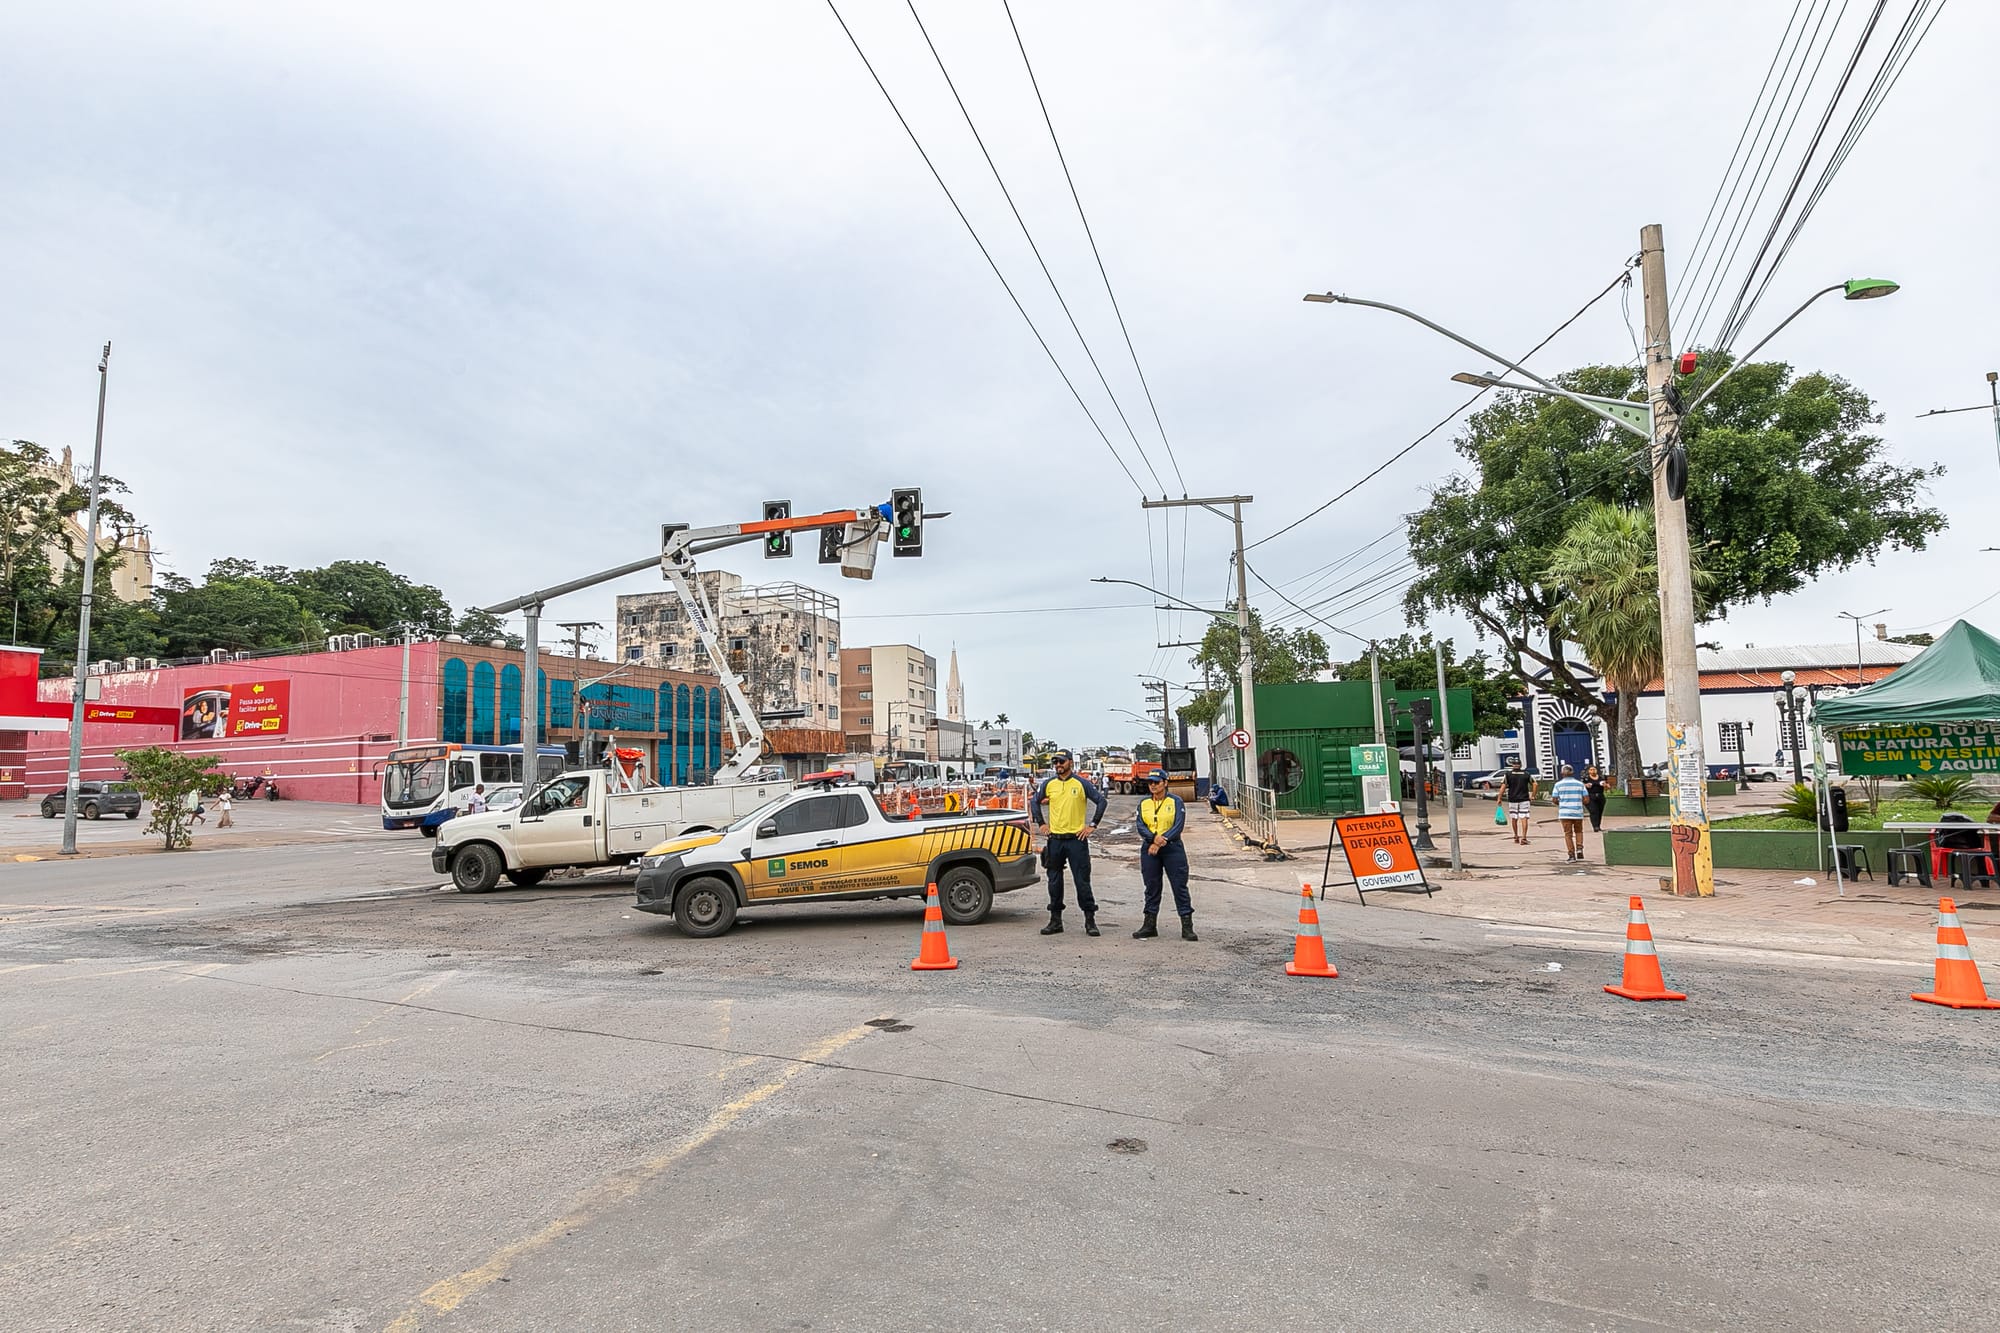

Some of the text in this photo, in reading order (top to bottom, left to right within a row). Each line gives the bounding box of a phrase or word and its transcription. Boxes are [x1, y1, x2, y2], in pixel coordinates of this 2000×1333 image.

[1842, 725, 1933, 740] MUTIRÃO
[1940, 726, 1968, 736] DO
[1843, 740, 1870, 751] NA
[1876, 737, 1954, 750] FATURA
[1960, 735, 1987, 747] DE
[1863, 750, 1905, 762] SEM
[1939, 758, 1997, 771] AQUI!
[1346, 819, 1396, 833] ATENÇÃO
[1350, 835, 1404, 850] DEVAGAR
[1376, 852, 1389, 863] 20
[790, 859, 829, 870] SEMOB
[1362, 872, 1416, 887] GOVERNO MT
[777, 885, 800, 894] LIGUE
